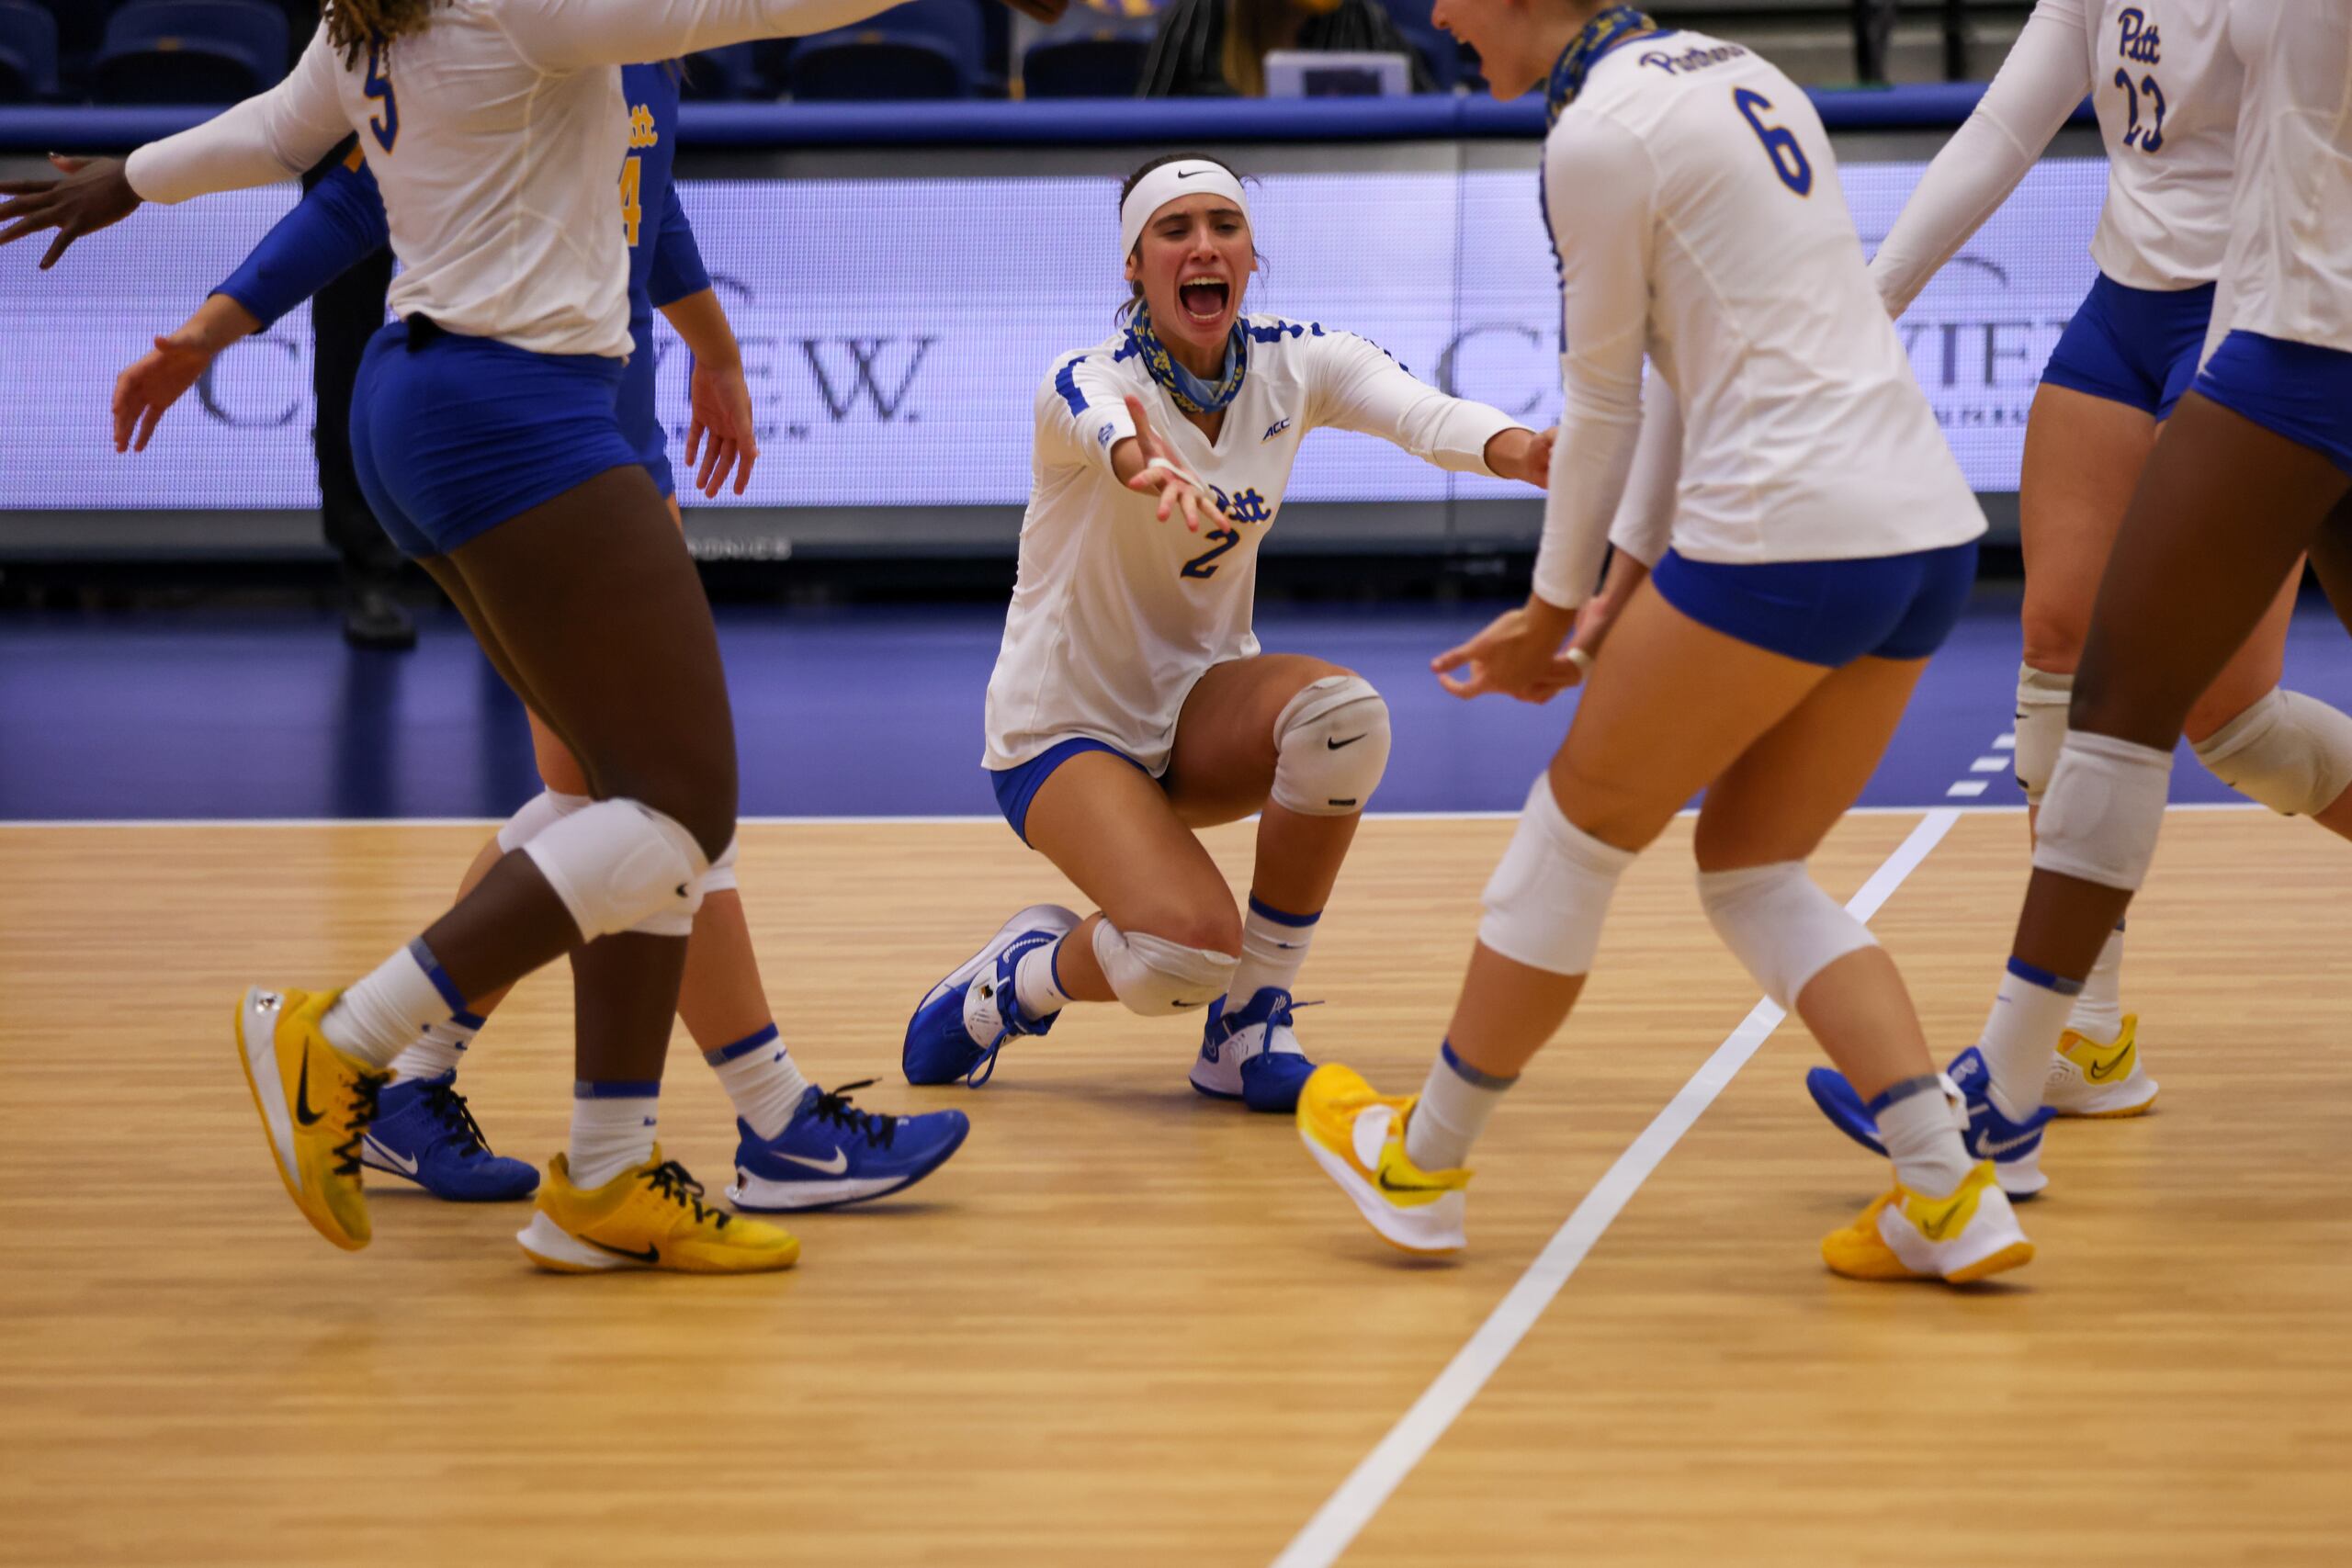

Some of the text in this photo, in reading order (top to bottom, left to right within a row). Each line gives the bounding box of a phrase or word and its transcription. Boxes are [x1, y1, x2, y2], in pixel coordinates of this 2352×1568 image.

[2118, 7, 2161, 65] Pitt
[1733, 85, 1814, 198] 6
[1261, 417, 1292, 442] ACC
[1180, 527, 1240, 580] 2
